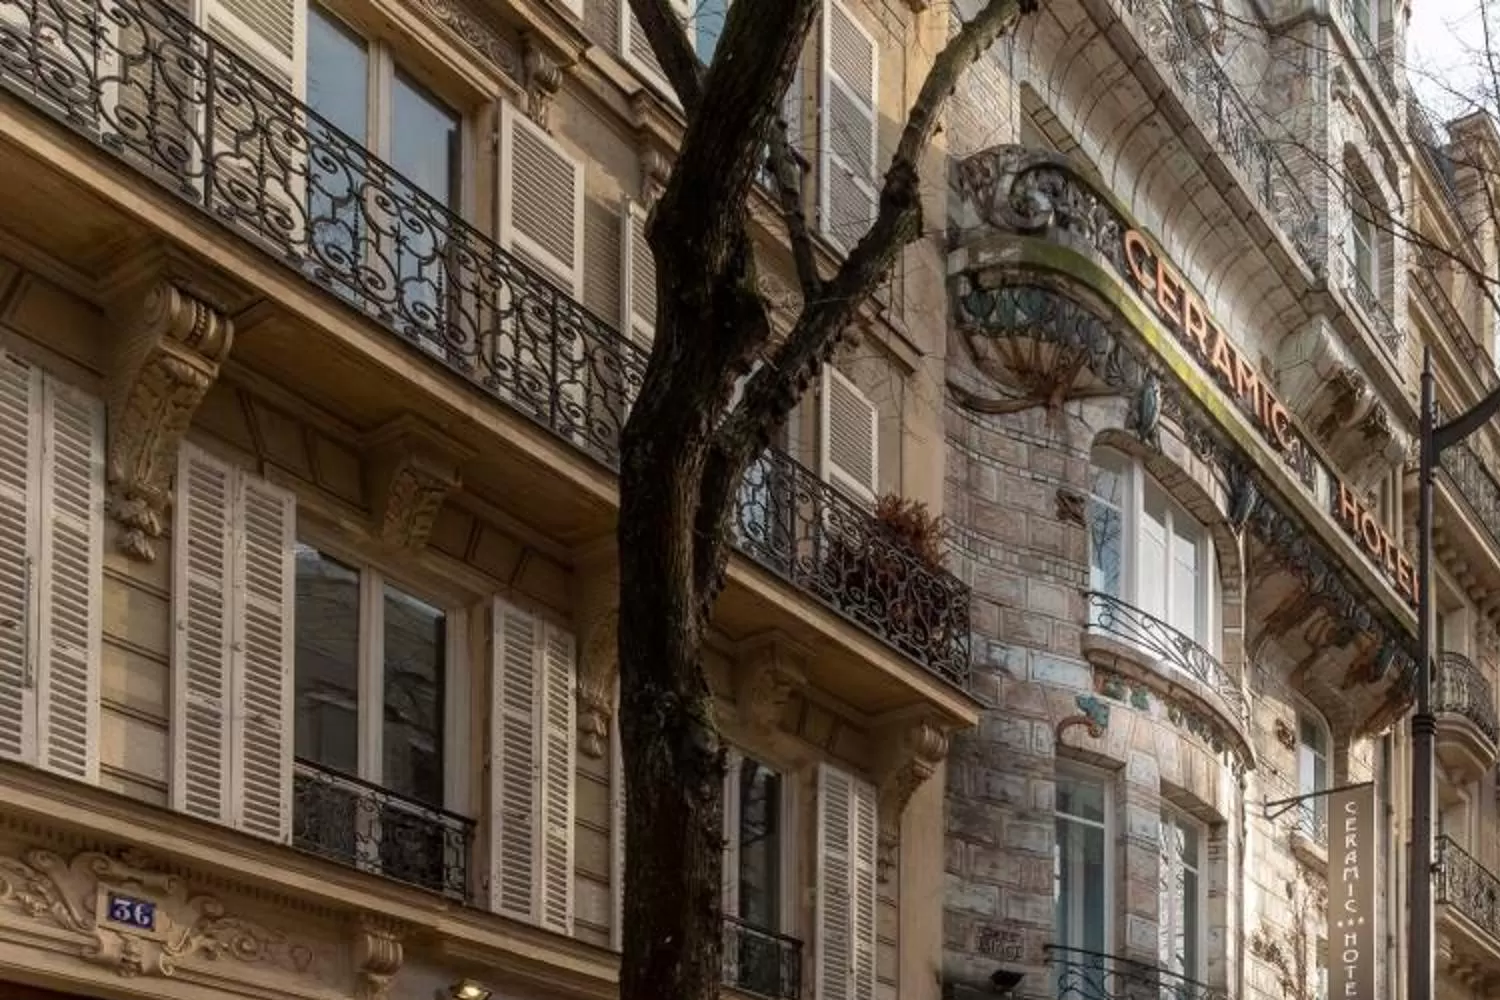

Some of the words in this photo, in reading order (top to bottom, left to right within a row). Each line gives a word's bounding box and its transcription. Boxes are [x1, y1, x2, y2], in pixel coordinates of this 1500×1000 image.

[1125, 230, 1296, 451] CERAMIC
[114, 897, 151, 925] 36
[1343, 801, 1359, 913] CERAMIC
